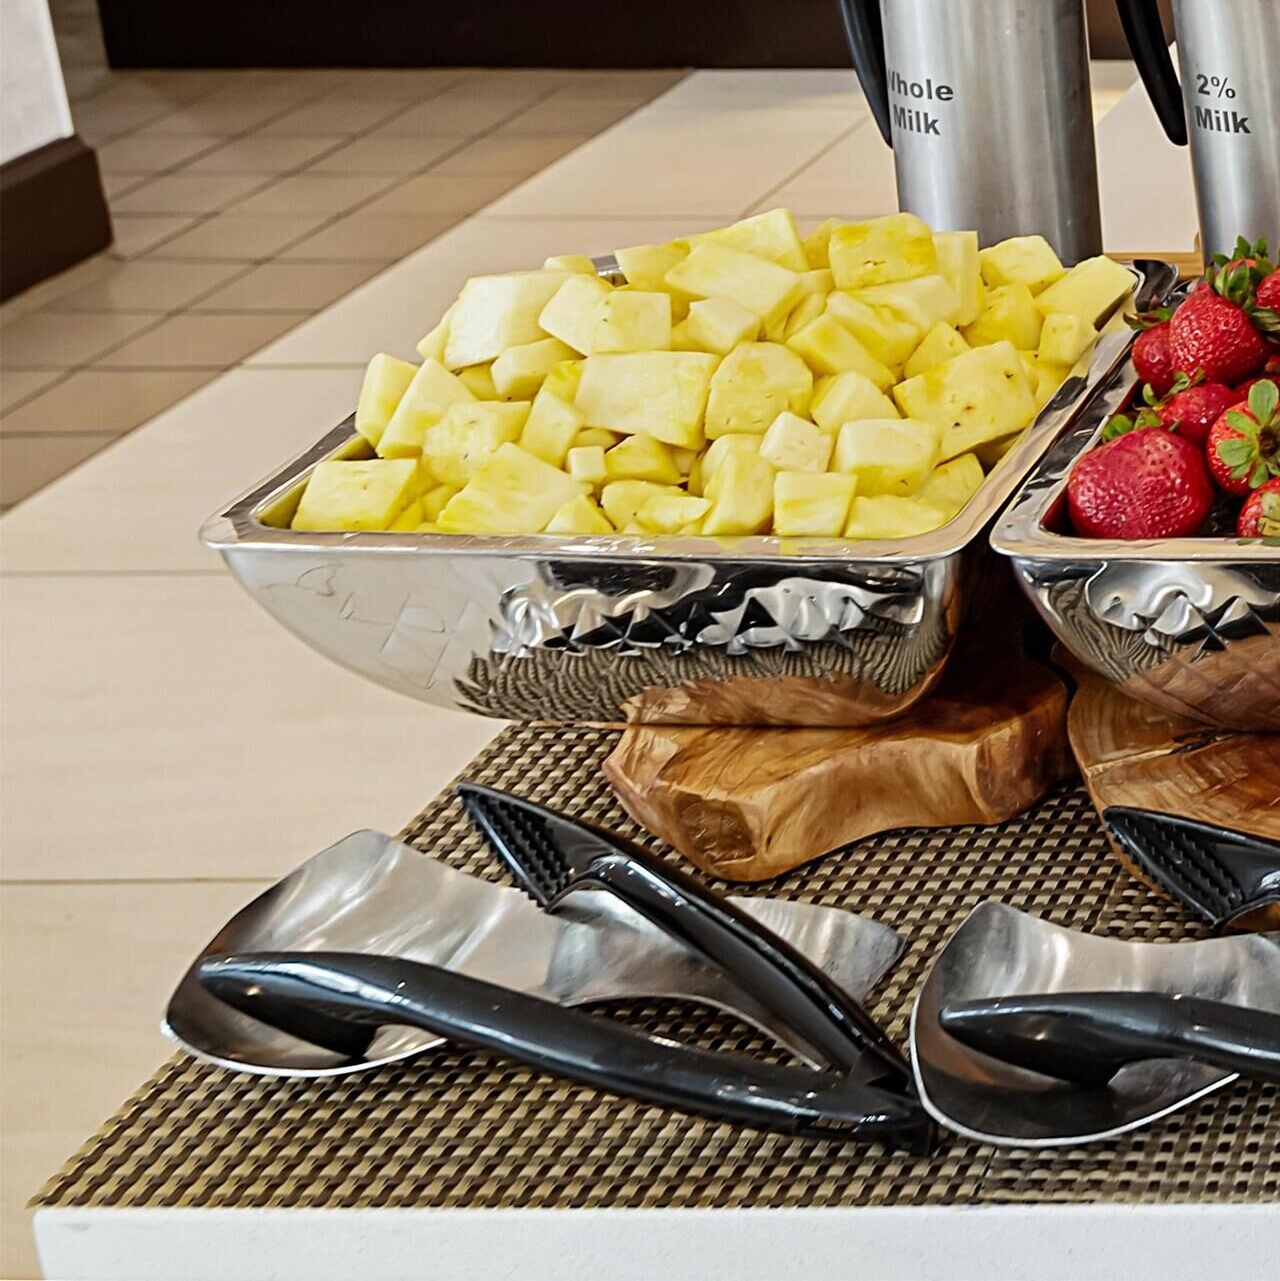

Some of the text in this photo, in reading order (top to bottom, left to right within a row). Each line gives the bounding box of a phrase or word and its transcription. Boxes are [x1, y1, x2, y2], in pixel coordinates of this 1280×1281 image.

[1196, 73, 1236, 99] 2%
[893, 103, 942, 136] Milk
[1195, 105, 1251, 134] Milk
